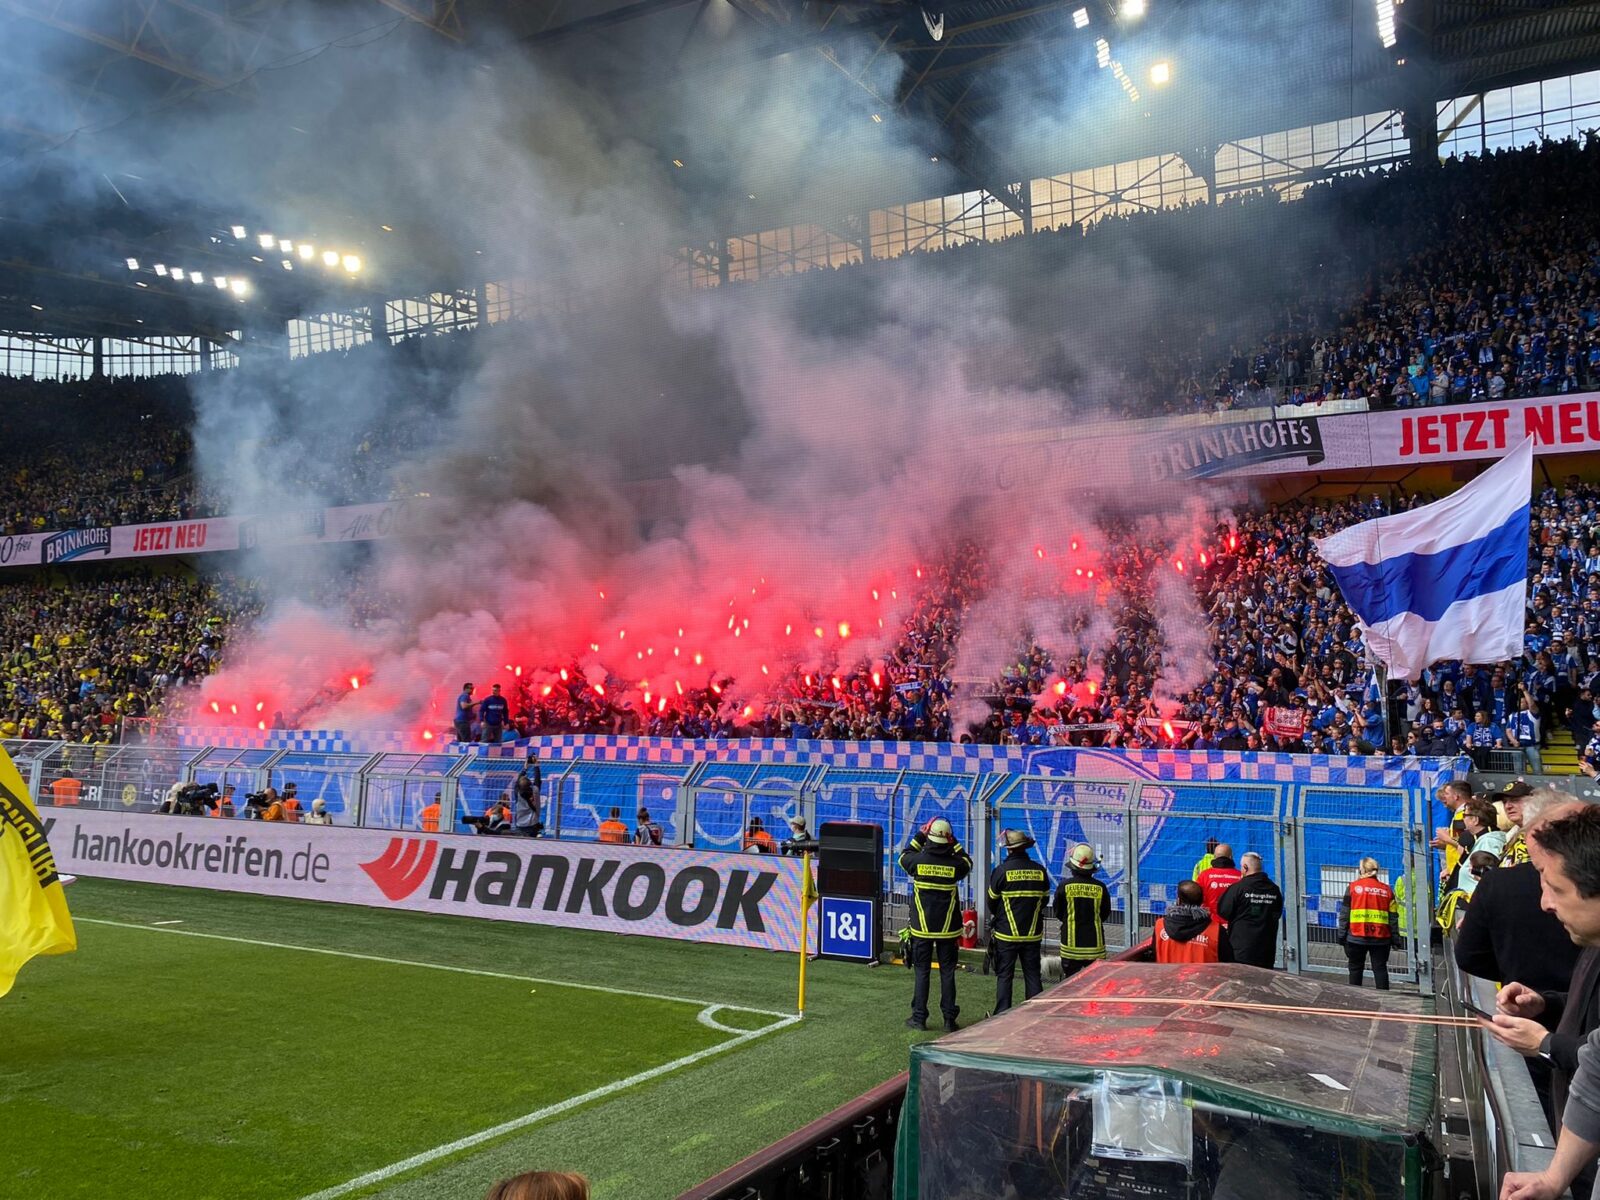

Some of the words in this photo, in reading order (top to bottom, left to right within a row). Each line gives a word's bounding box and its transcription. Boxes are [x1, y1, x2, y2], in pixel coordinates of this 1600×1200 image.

[1398, 408, 1509, 456] JETZT
[133, 526, 173, 552] JETZT
[175, 523, 208, 549] NEU
[72, 823, 330, 884] hankookreifen.de
[827, 911, 866, 942] 1&1
